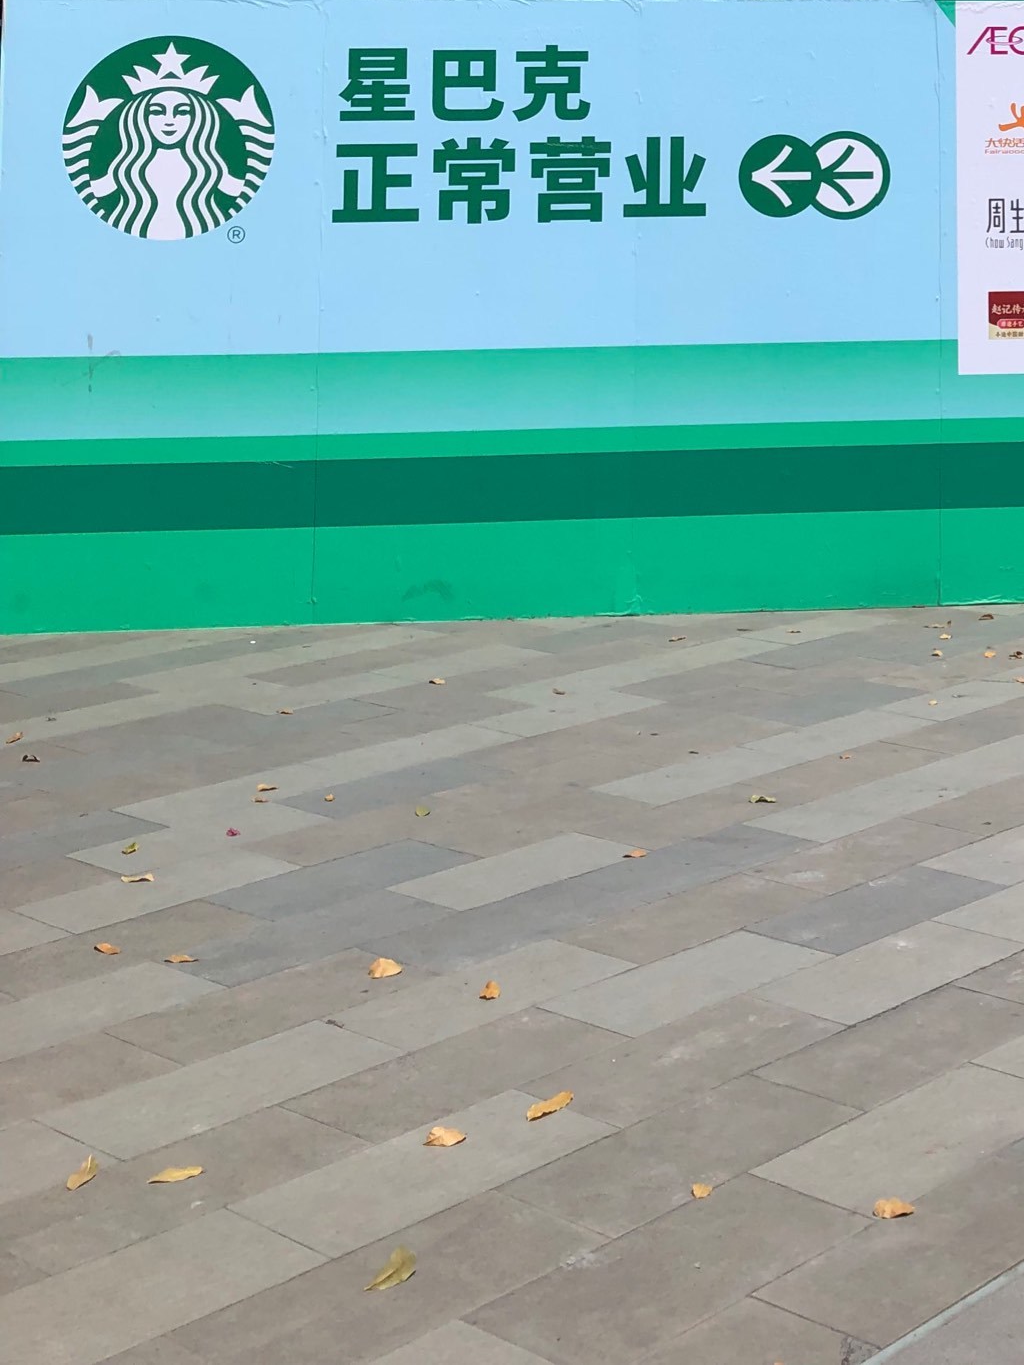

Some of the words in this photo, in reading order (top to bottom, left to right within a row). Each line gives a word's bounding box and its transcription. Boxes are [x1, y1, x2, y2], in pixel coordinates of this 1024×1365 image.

[338, 44, 591, 122] 星巴克
[332, 135, 707, 225] 正常营业
